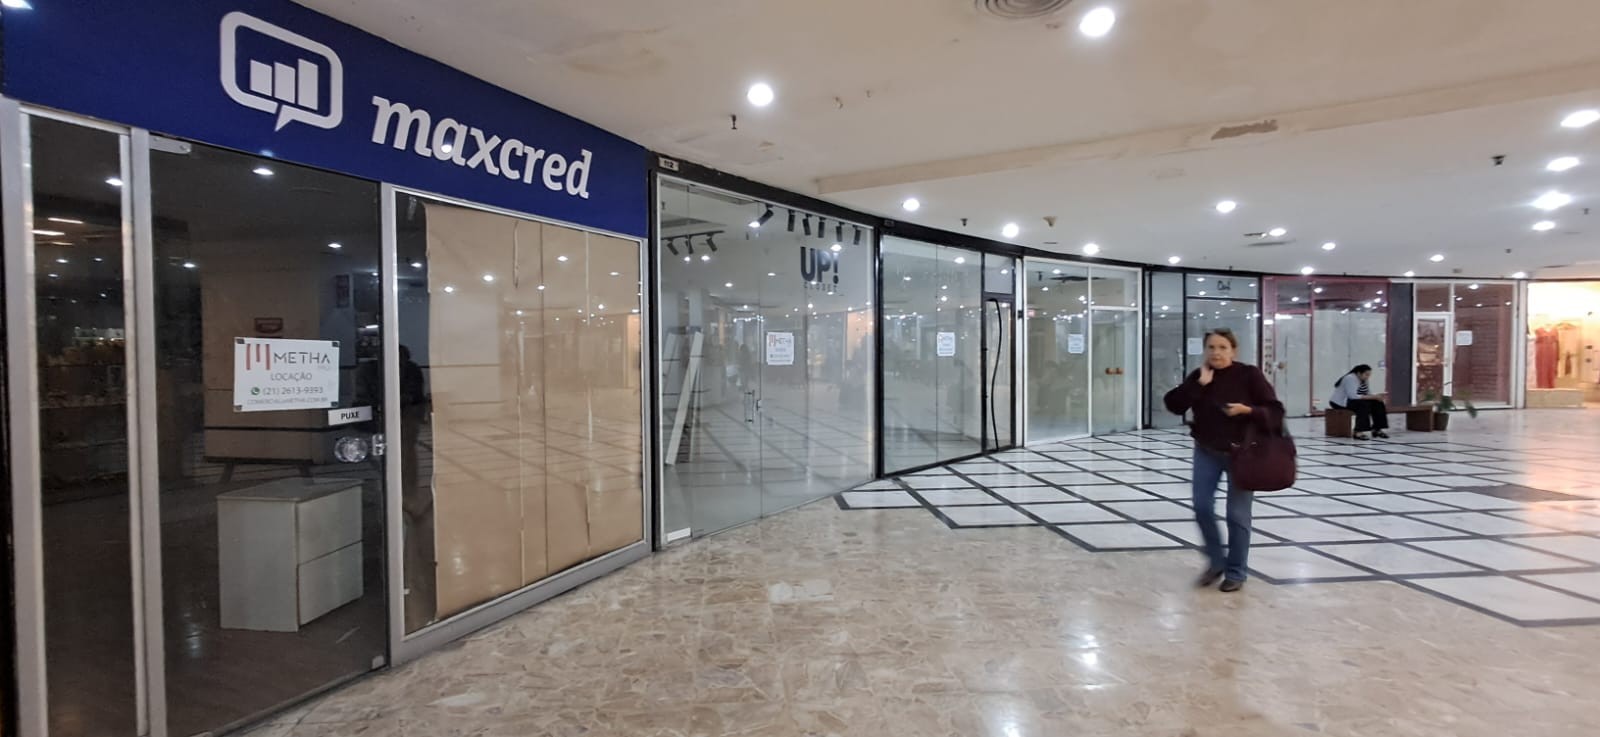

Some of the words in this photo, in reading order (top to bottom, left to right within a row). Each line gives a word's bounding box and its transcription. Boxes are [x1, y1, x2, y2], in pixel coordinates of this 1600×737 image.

[372, 96, 592, 199] maxcred
[800, 246, 839, 284] UP!
[273, 352, 331, 364] METHA
[271, 372, 312, 381] LOCAÇÃO
[263, 387, 280, 396] (21)
[341, 411, 359, 420] PUXE
